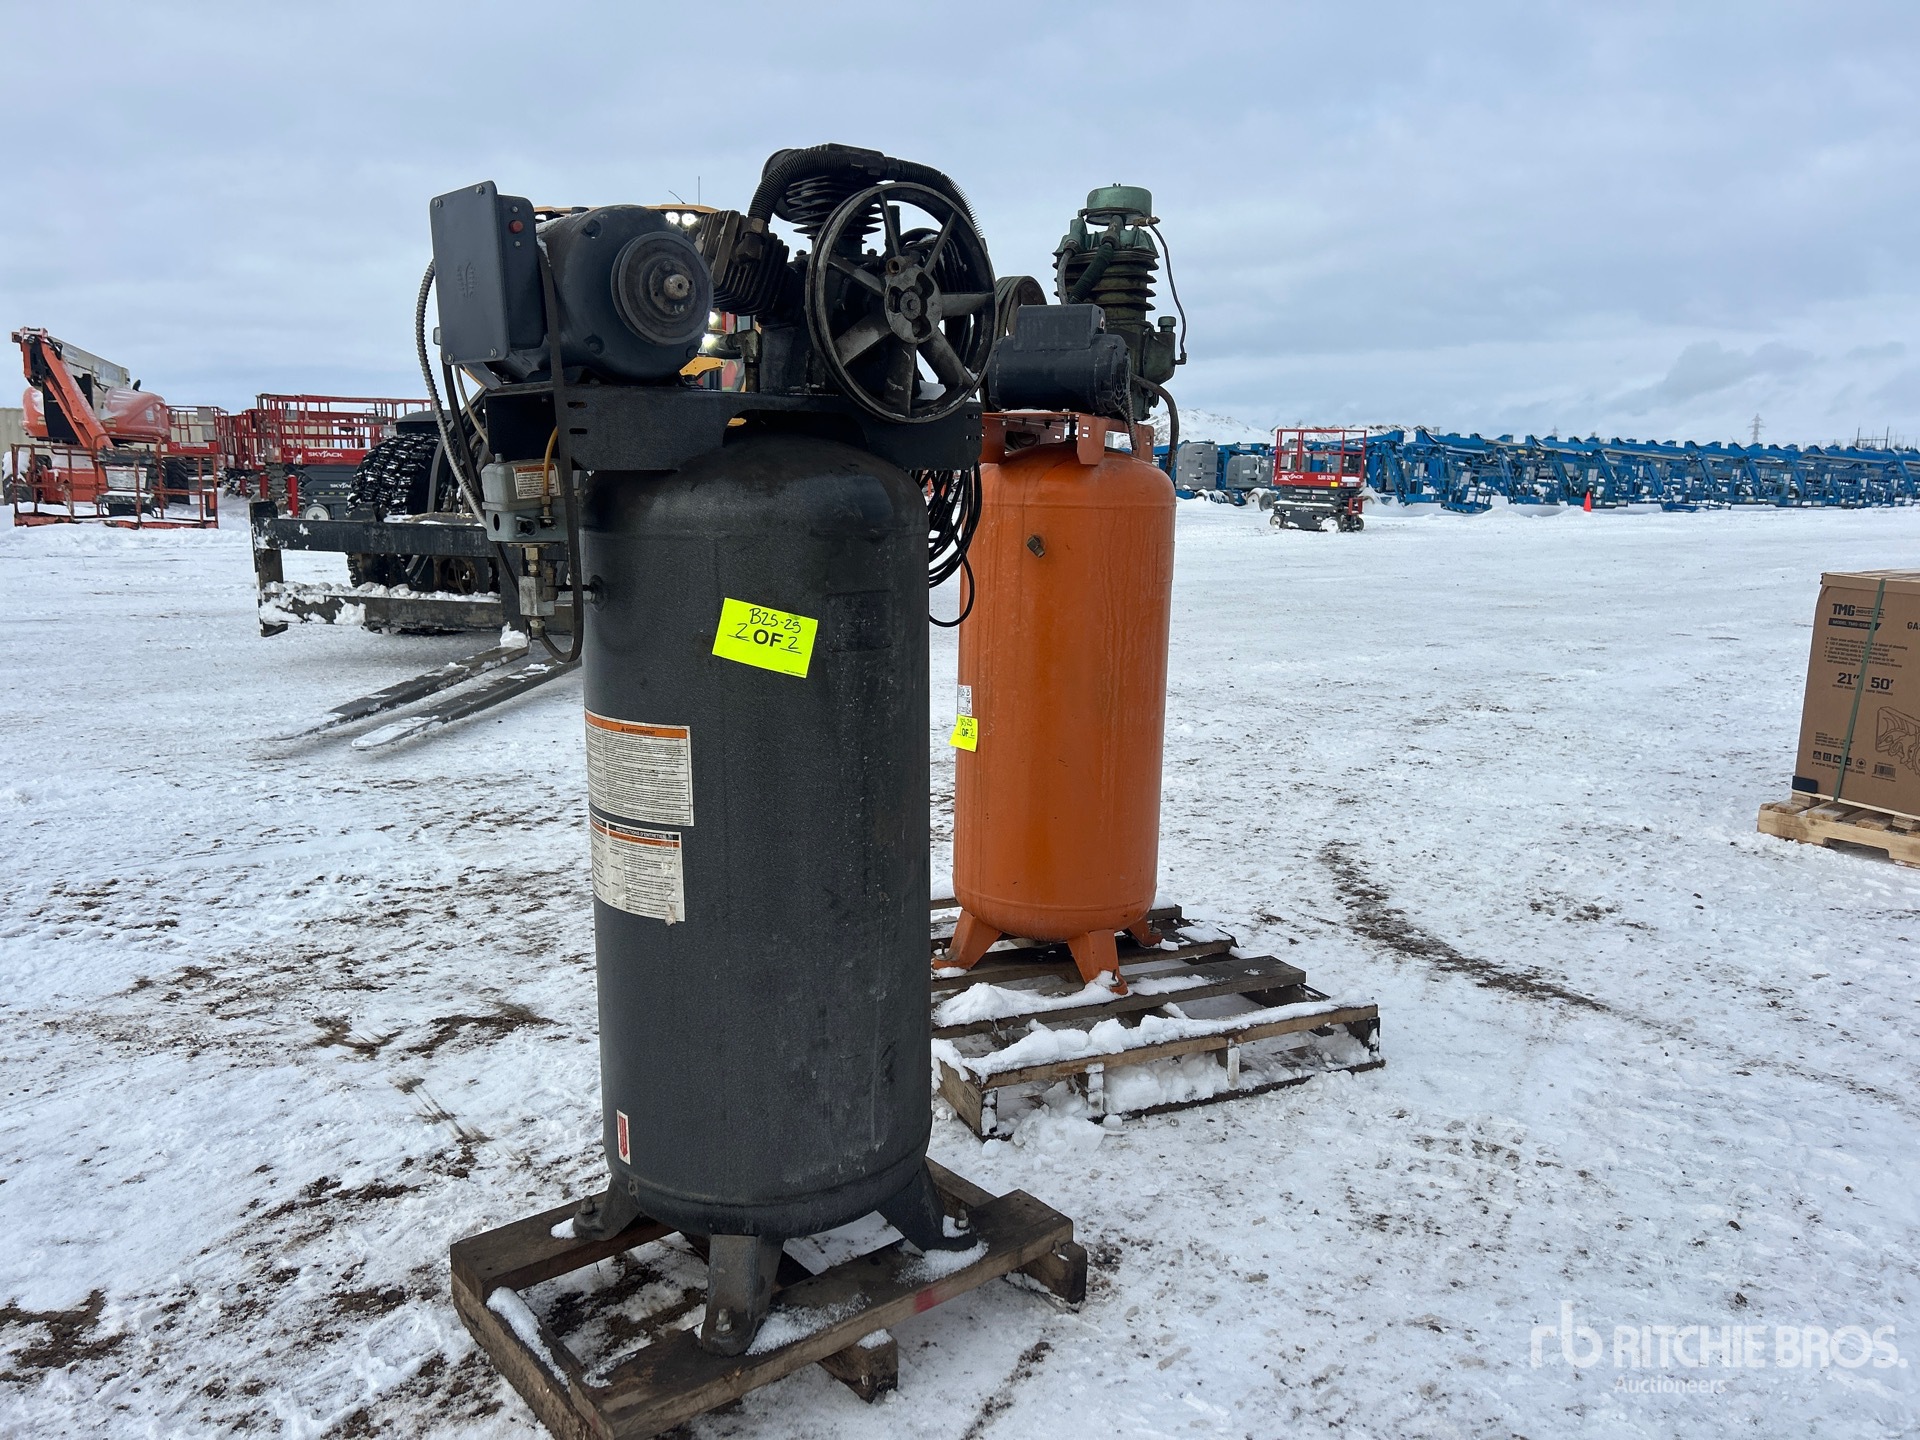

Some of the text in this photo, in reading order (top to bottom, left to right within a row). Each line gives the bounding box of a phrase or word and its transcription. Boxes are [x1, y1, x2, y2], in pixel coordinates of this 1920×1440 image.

[308, 450, 343, 458] SKYJACK
[1832, 603, 1856, 616] TMG
[735, 623, 800, 650] 2 OF 2
[962, 728, 969, 737] OF
[970, 728, 975, 737] 2
